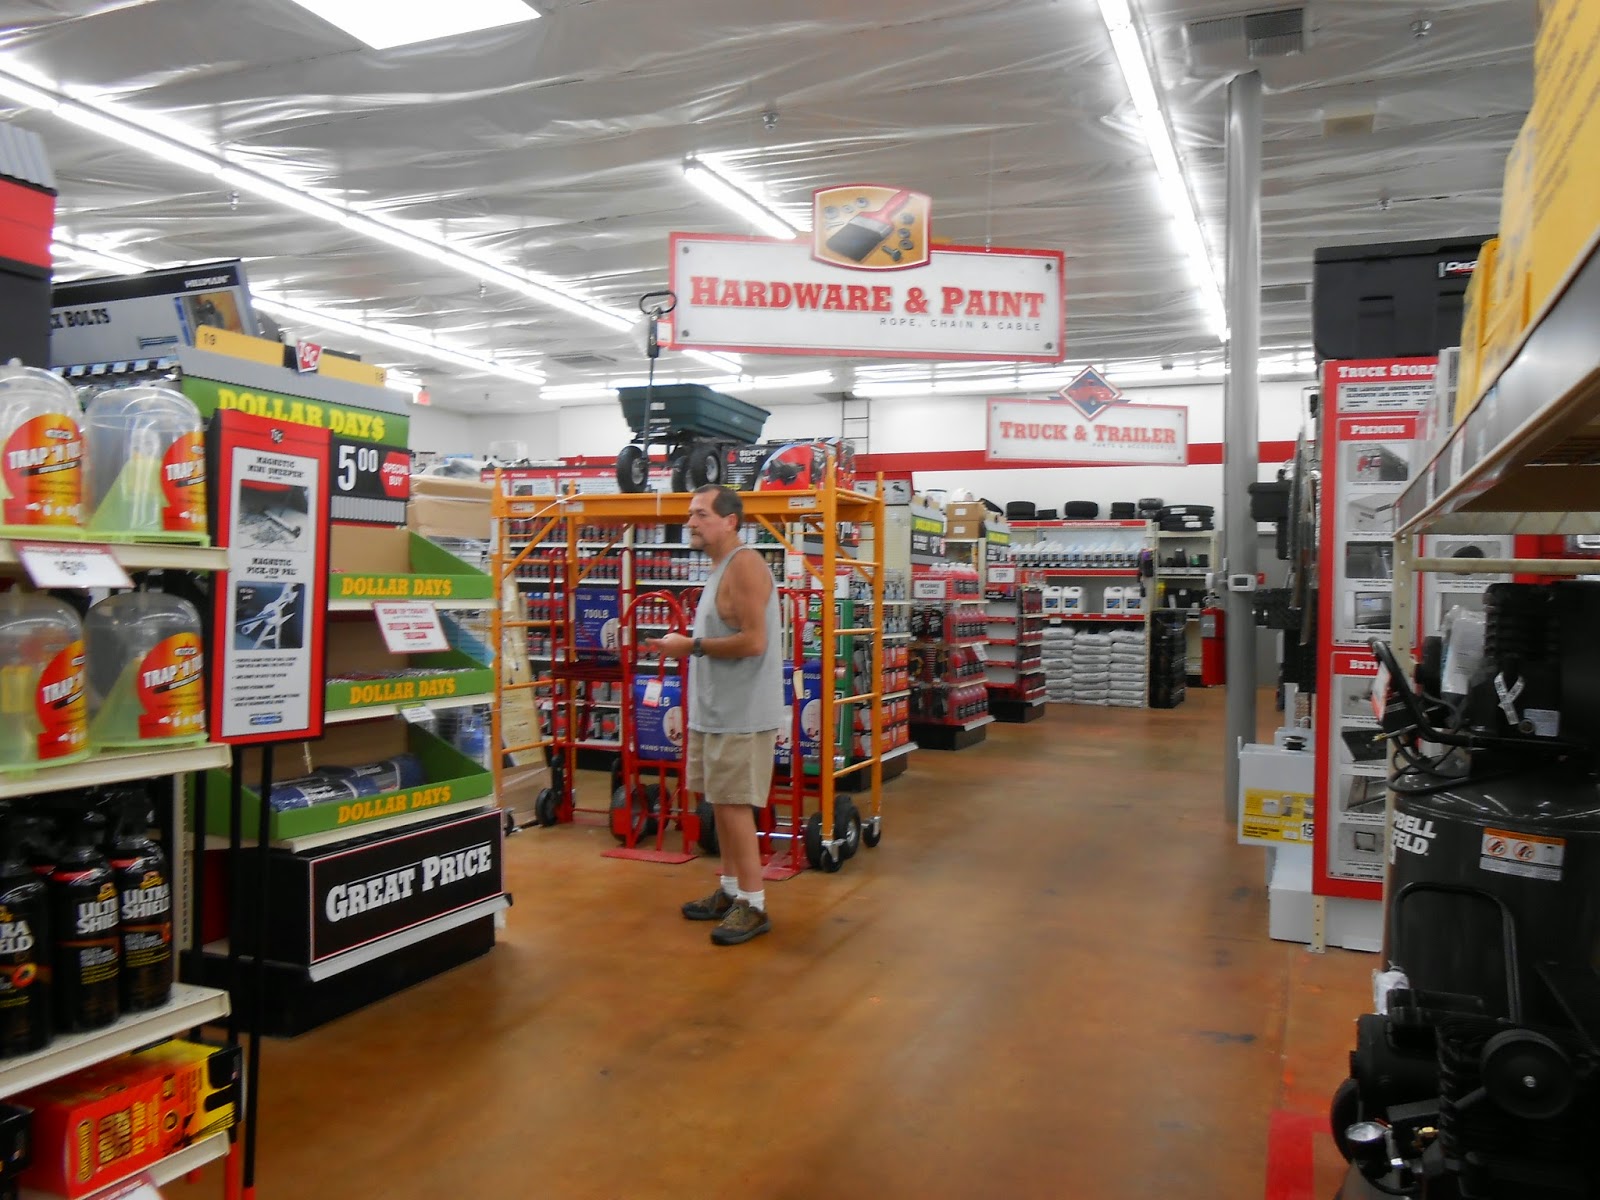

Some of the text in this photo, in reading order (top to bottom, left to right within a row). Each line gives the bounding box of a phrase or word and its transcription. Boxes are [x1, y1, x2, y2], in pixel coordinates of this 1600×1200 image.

[690, 276, 1044, 318] HARDWARE & PAINT
[65, 308, 111, 328] BOLTS
[930, 319, 974, 329] CHAIN
[982, 321, 991, 330] &
[997, 321, 1041, 332] CABLE
[1337, 366, 1388, 378] TRUCK
[218, 389, 324, 427] DOLLAR
[1000, 421, 1176, 444] TRUCK & TRAILER
[8, 447, 49, 469] TRAP
[739, 449, 767, 457] BENCH
[166, 463, 193, 481] TRAP
[389, 475, 403, 486] BUY
[341, 577, 410, 596] DOLLAR
[583, 609, 609, 619] 700LB
[143, 665, 177, 688] TRAP
[43, 679, 73, 704] TRAP
[350, 682, 414, 704] DOLLAR
[338, 796, 407, 825] DOLLAR
[326, 844, 492, 922] GREAT PRICE
